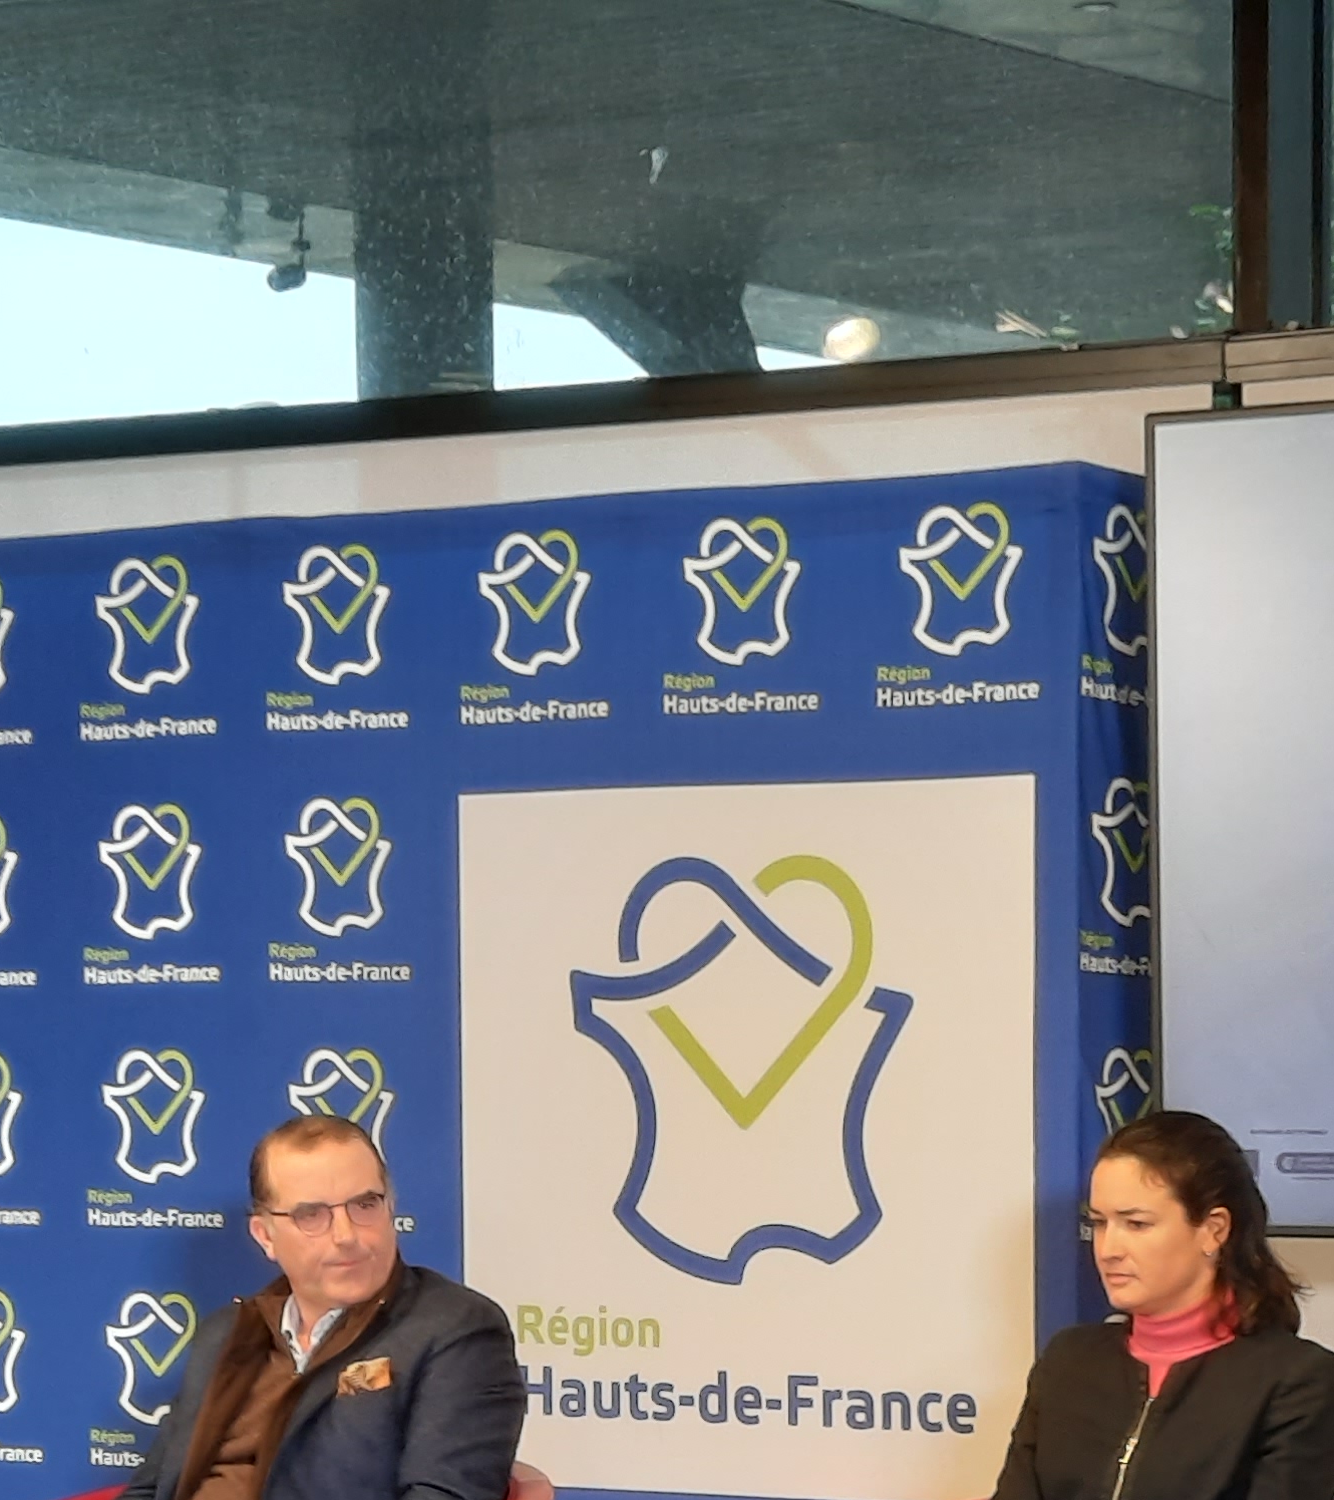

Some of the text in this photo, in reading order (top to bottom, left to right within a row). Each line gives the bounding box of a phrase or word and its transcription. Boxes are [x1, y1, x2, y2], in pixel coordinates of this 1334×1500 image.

[663, 672, 715, 693] Région
[877, 665, 931, 686] Région
[266, 692, 313, 710] Région
[460, 684, 510, 705] Région
[663, 691, 819, 714] Hauts-de-France
[876, 681, 1040, 708] Hauts-de-France
[266, 709, 409, 731] Hauts-de-France
[460, 700, 610, 725] Hauts-de-France
[80, 717, 217, 741] Hauts-de-France
[268, 942, 316, 960] Région
[83, 964, 221, 985] Hauts-de-France
[269, 960, 412, 984] Hauts-de-France
[86, 1189, 133, 1206] Région
[87, 1205, 224, 1228] Hauts-de-France
[516, 1304, 661, 1356] Région
[517, 1366, 977, 1434] Hauts-de-France
